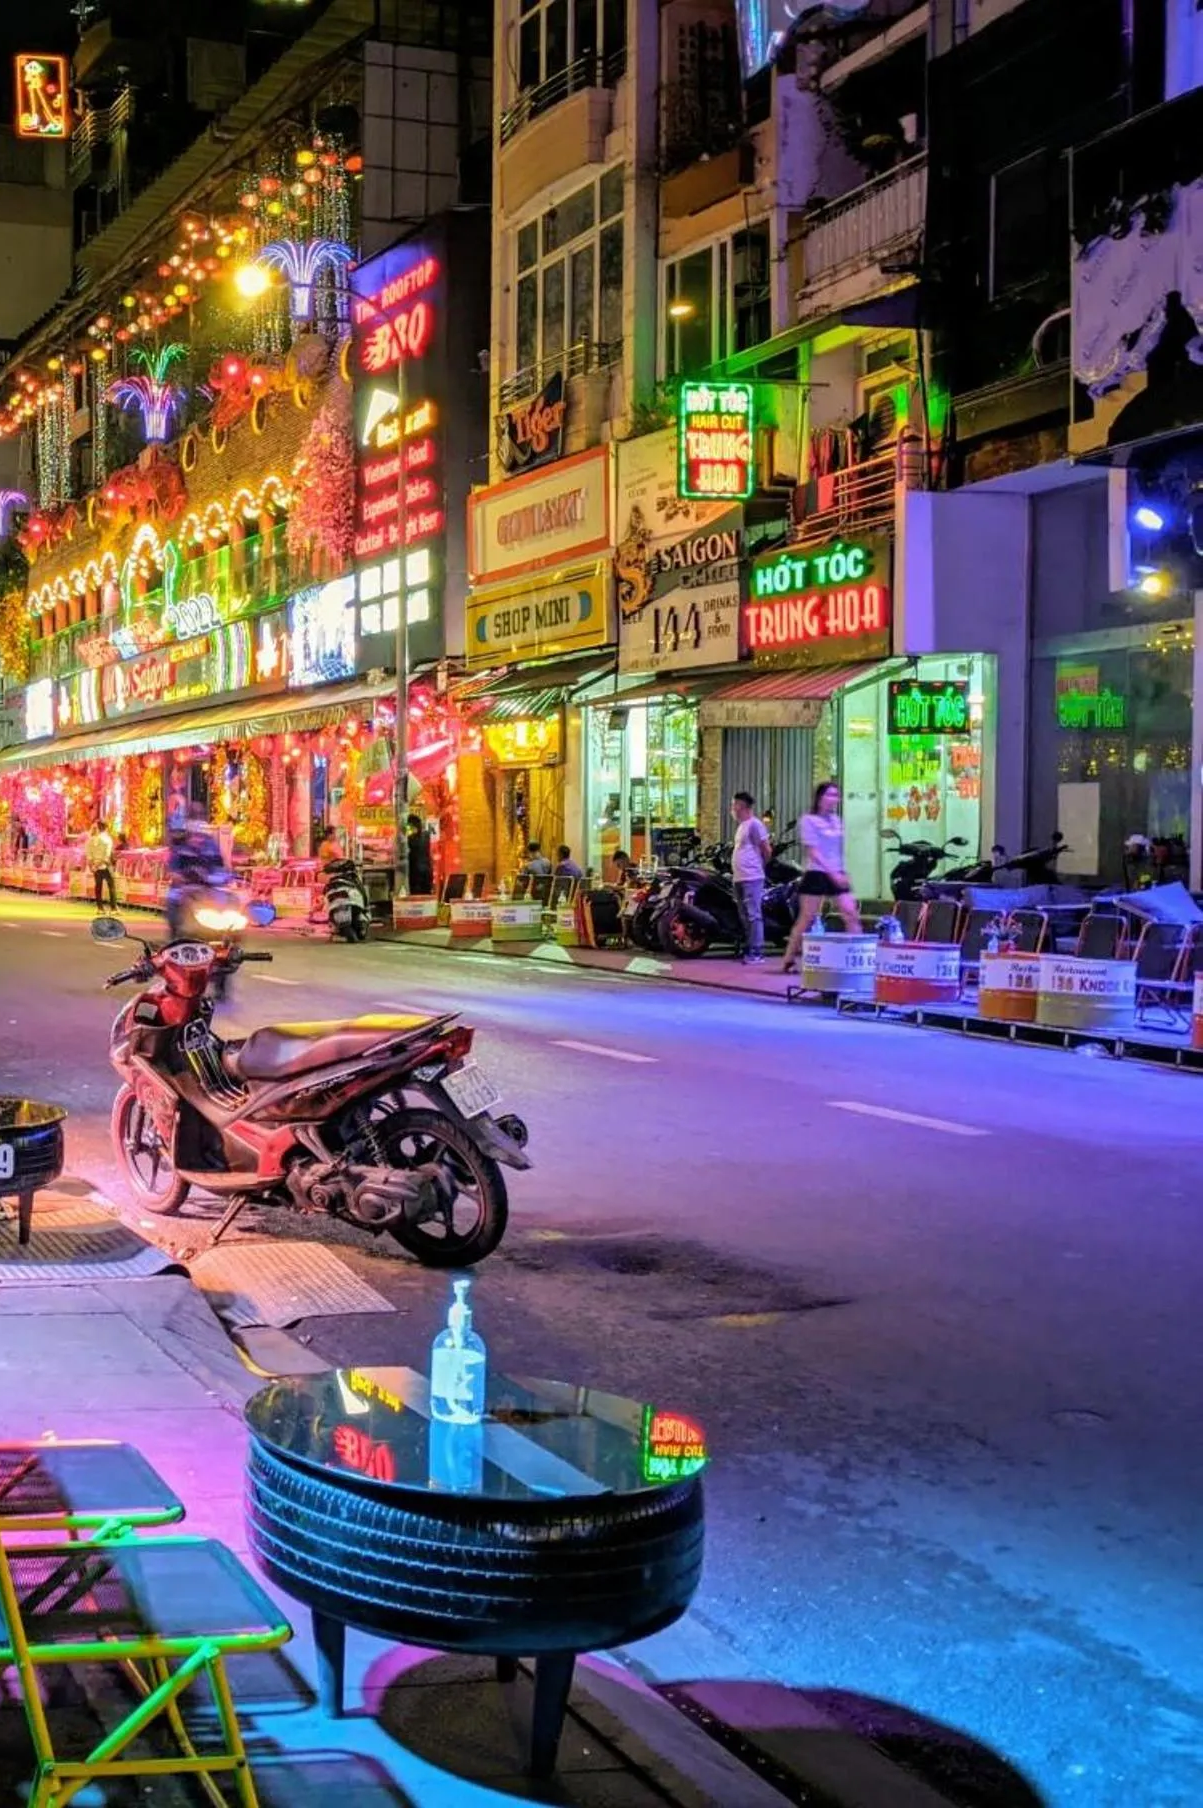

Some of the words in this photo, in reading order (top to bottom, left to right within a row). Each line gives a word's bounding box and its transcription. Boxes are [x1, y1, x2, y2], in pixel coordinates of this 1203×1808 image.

[511, 396, 566, 451] Tiger
[721, 415, 743, 429] CUT
[660, 530, 737, 572] SAIGON
[756, 554, 807, 596] HỚT
[813, 543, 865, 584] TÓC
[493, 606, 531, 640] SHOP
[534, 596, 571, 630] MINI
[745, 595, 820, 647] TRUNG
[826, 585, 880, 635] HOA
[932, 686, 965, 728] TÓC
